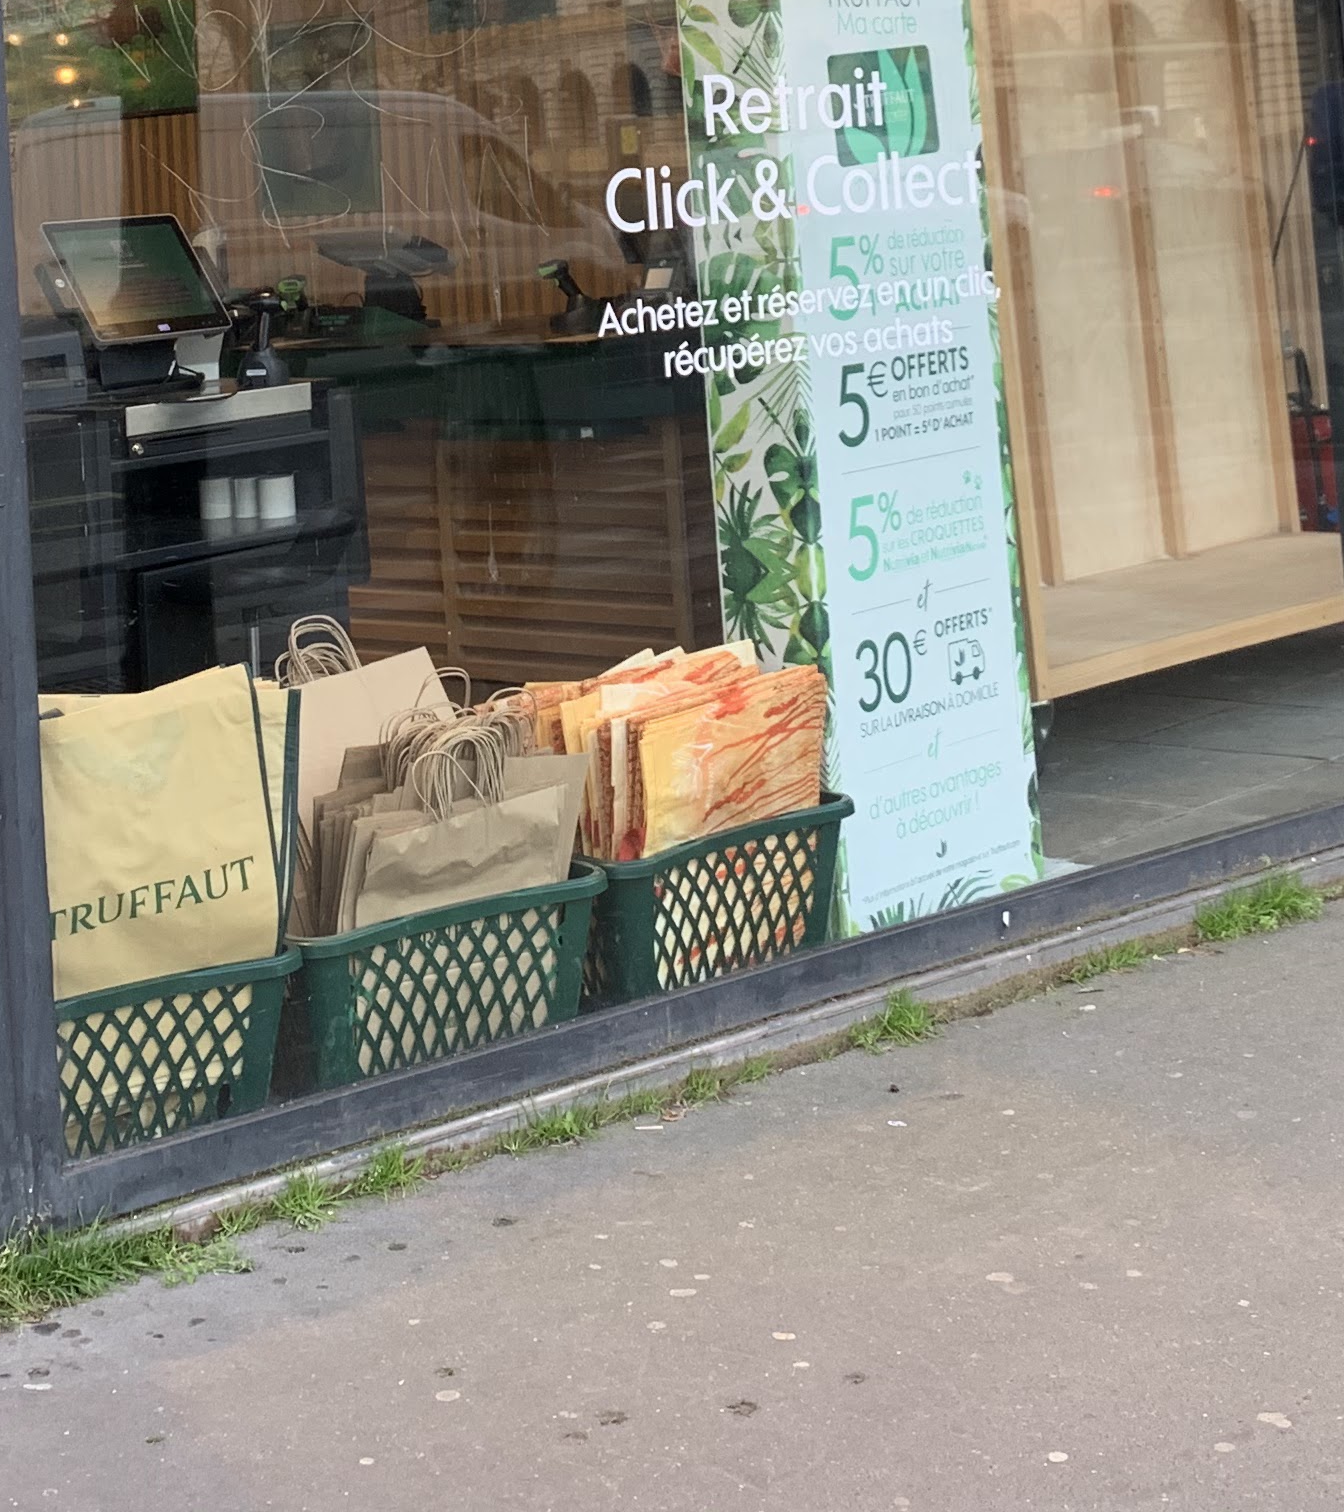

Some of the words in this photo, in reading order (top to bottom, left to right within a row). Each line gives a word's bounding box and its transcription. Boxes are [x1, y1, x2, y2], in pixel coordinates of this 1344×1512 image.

[837, 12, 867, 35] Ma
[873, 13, 917, 35] carte
[702, 68, 888, 137] Retrait
[605, 163, 739, 234] Click
[752, 160, 792, 221] &
[806, 151, 983, 218] Collect
[888, 229, 905, 251] de
[890, 255, 916, 277] sur
[921, 248, 966, 273] votre
[598, 293, 719, 337] Achetez
[722, 294, 752, 323] et
[756, 284, 872, 321] réservez
[876, 278, 911, 306] en
[917, 274, 950, 302] un
[664, 335, 808, 378] récupérez
[811, 330, 858, 358] vos
[863, 316, 954, 354] achats
[891, 346, 969, 382] OFFERTS
[893, 387, 907, 402] en
[908, 382, 931, 400] bon
[881, 423, 912, 442] POINT
[910, 515, 985, 547] CROQUETTES
[917, 579, 933, 612] et
[860, 719, 879, 738] SUR
[880, 716, 894, 732] LA
[894, 699, 946, 728] LIVRAISON
[956, 681, 999, 707] DOMICILE
[928, 727, 942, 760] et
[869, 786, 927, 820] d'autres
[929, 761, 1002, 799] avantages
[909, 794, 972, 834] découvrir
[49, 855, 255, 940] TRUFFAUT
